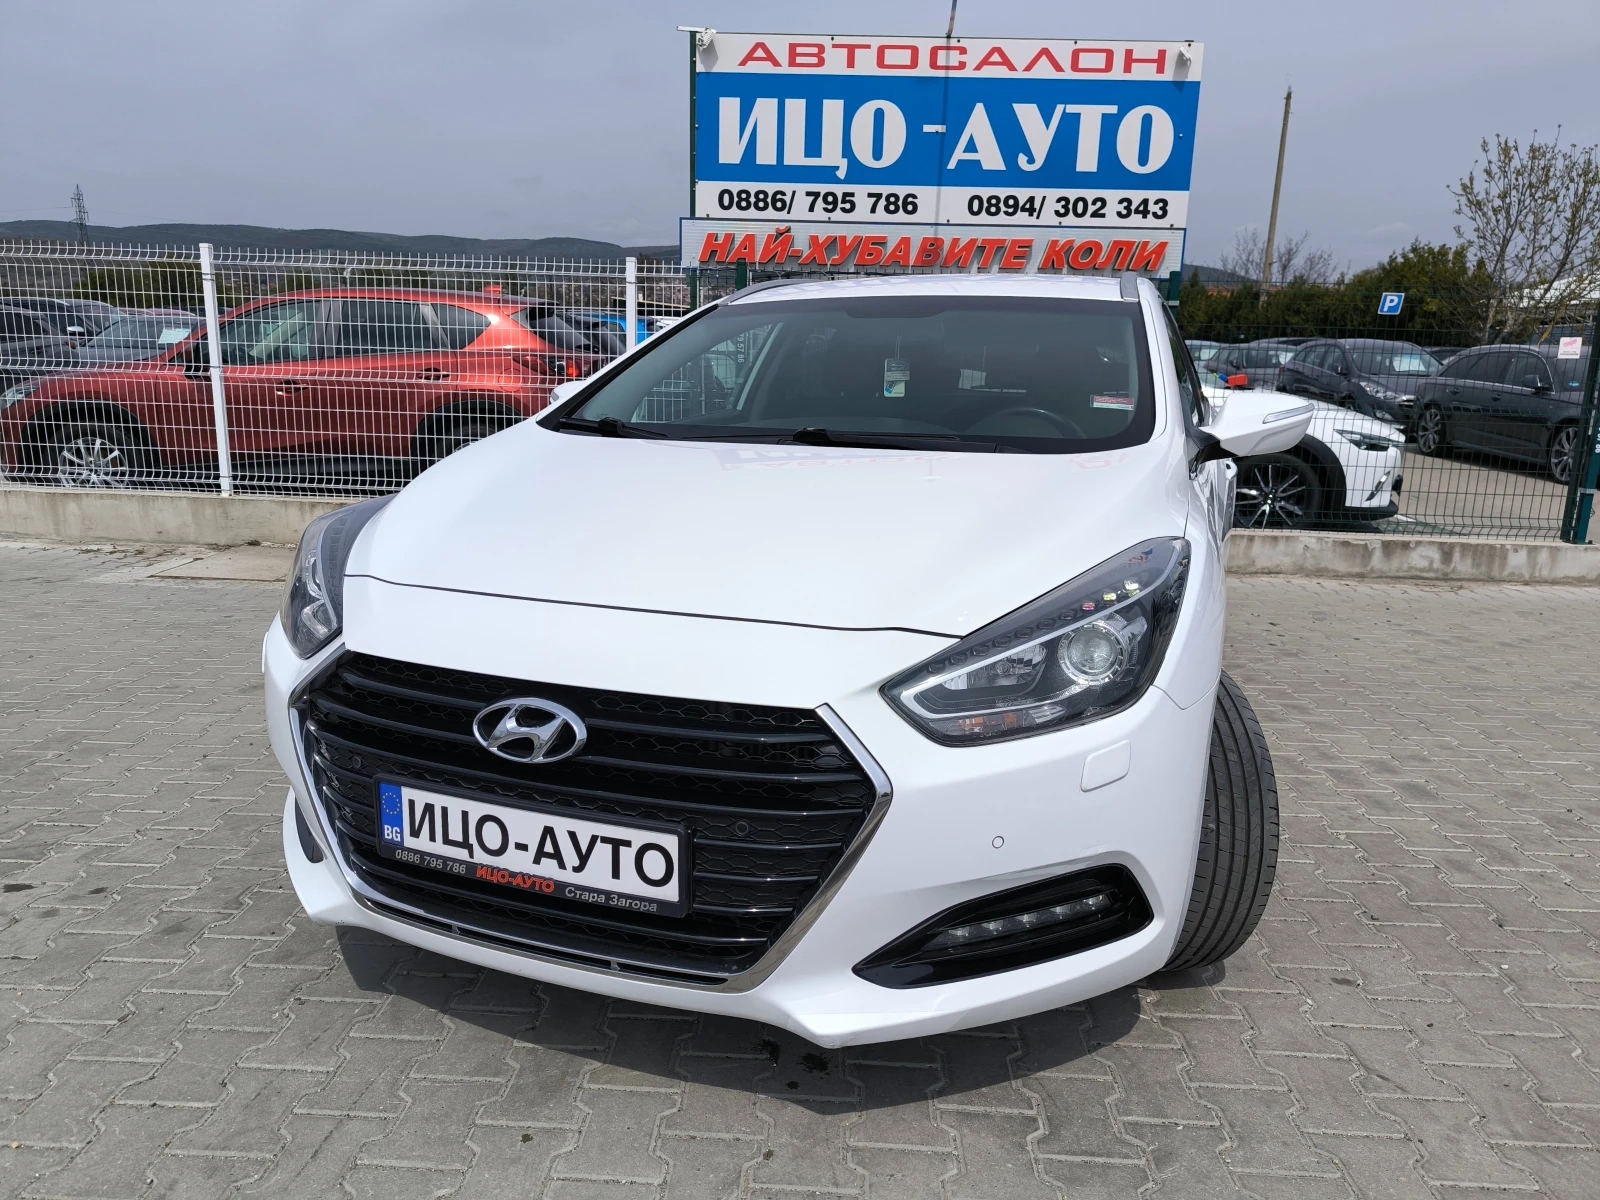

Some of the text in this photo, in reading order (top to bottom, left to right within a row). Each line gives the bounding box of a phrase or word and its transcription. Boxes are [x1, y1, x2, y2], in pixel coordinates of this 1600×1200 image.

[738, 41, 1167, 75] АВТОСАЛОН
[717, 188, 919, 216] 0886/ 795 786
[967, 194, 1169, 220] 0894/ 302 343
[698, 225, 1169, 271] НАЙ-ХУБАВИТЕ КОЛИ
[1383, 295, 1399, 312] P
[384, 824, 401, 842] BG
[408, 798, 675, 888] ИЦО-АУТО
[395, 849, 658, 912] 0886 795 786 ИЦО-АУТО Стара Загора
